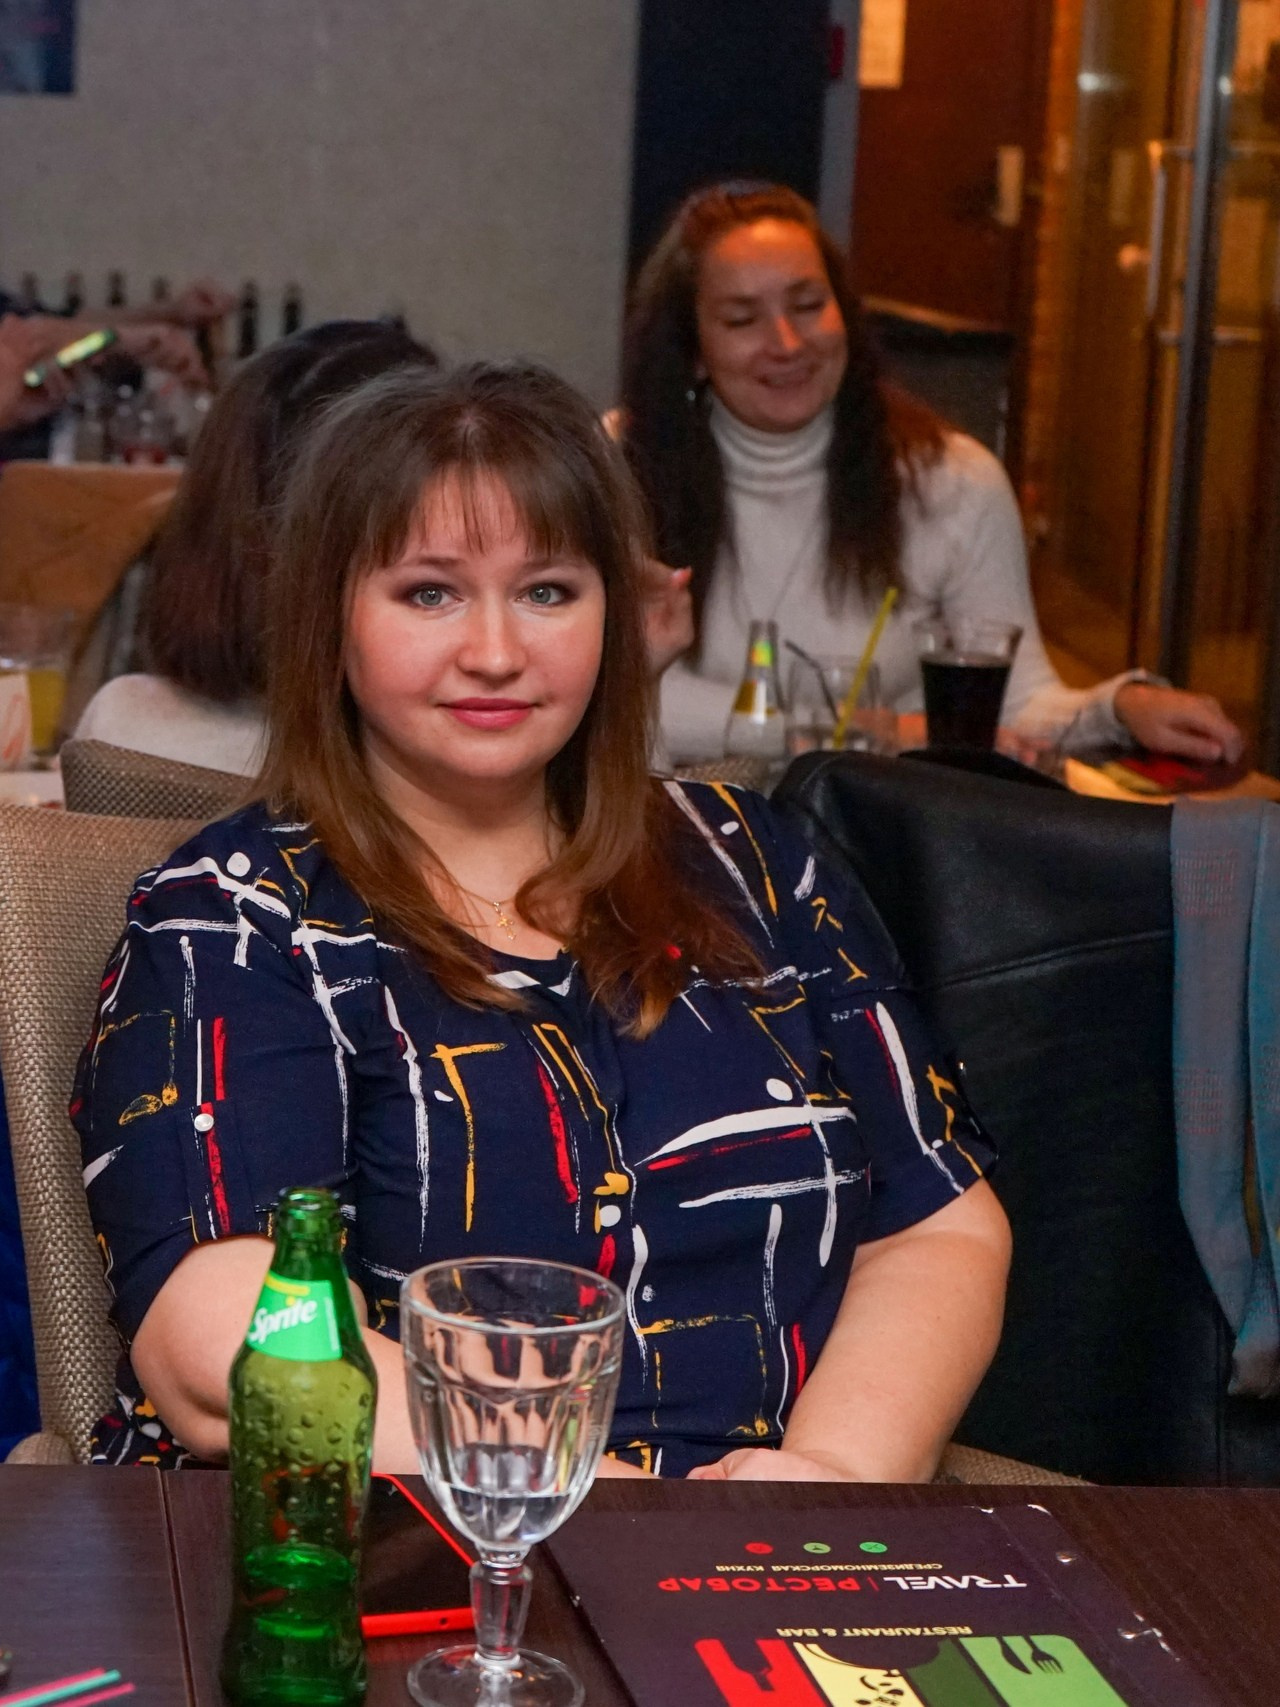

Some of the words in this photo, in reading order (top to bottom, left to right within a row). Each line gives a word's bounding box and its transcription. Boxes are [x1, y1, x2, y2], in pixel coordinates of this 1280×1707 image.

[248, 1296, 318, 1344] Sprite
[716, 1564, 765, 1572] КУХНЯ
[771, 1562, 943, 1571] СРЕДИЗЕМНОМОРСКАЯ
[658, 1576, 861, 1592] РЕСТОБАР
[883, 1574, 1027, 1590] TRAVEL
[776, 1628, 820, 1637] BAR
[822, 1627, 837, 1637] &
[843, 1625, 973, 1636] RESTAURANT
